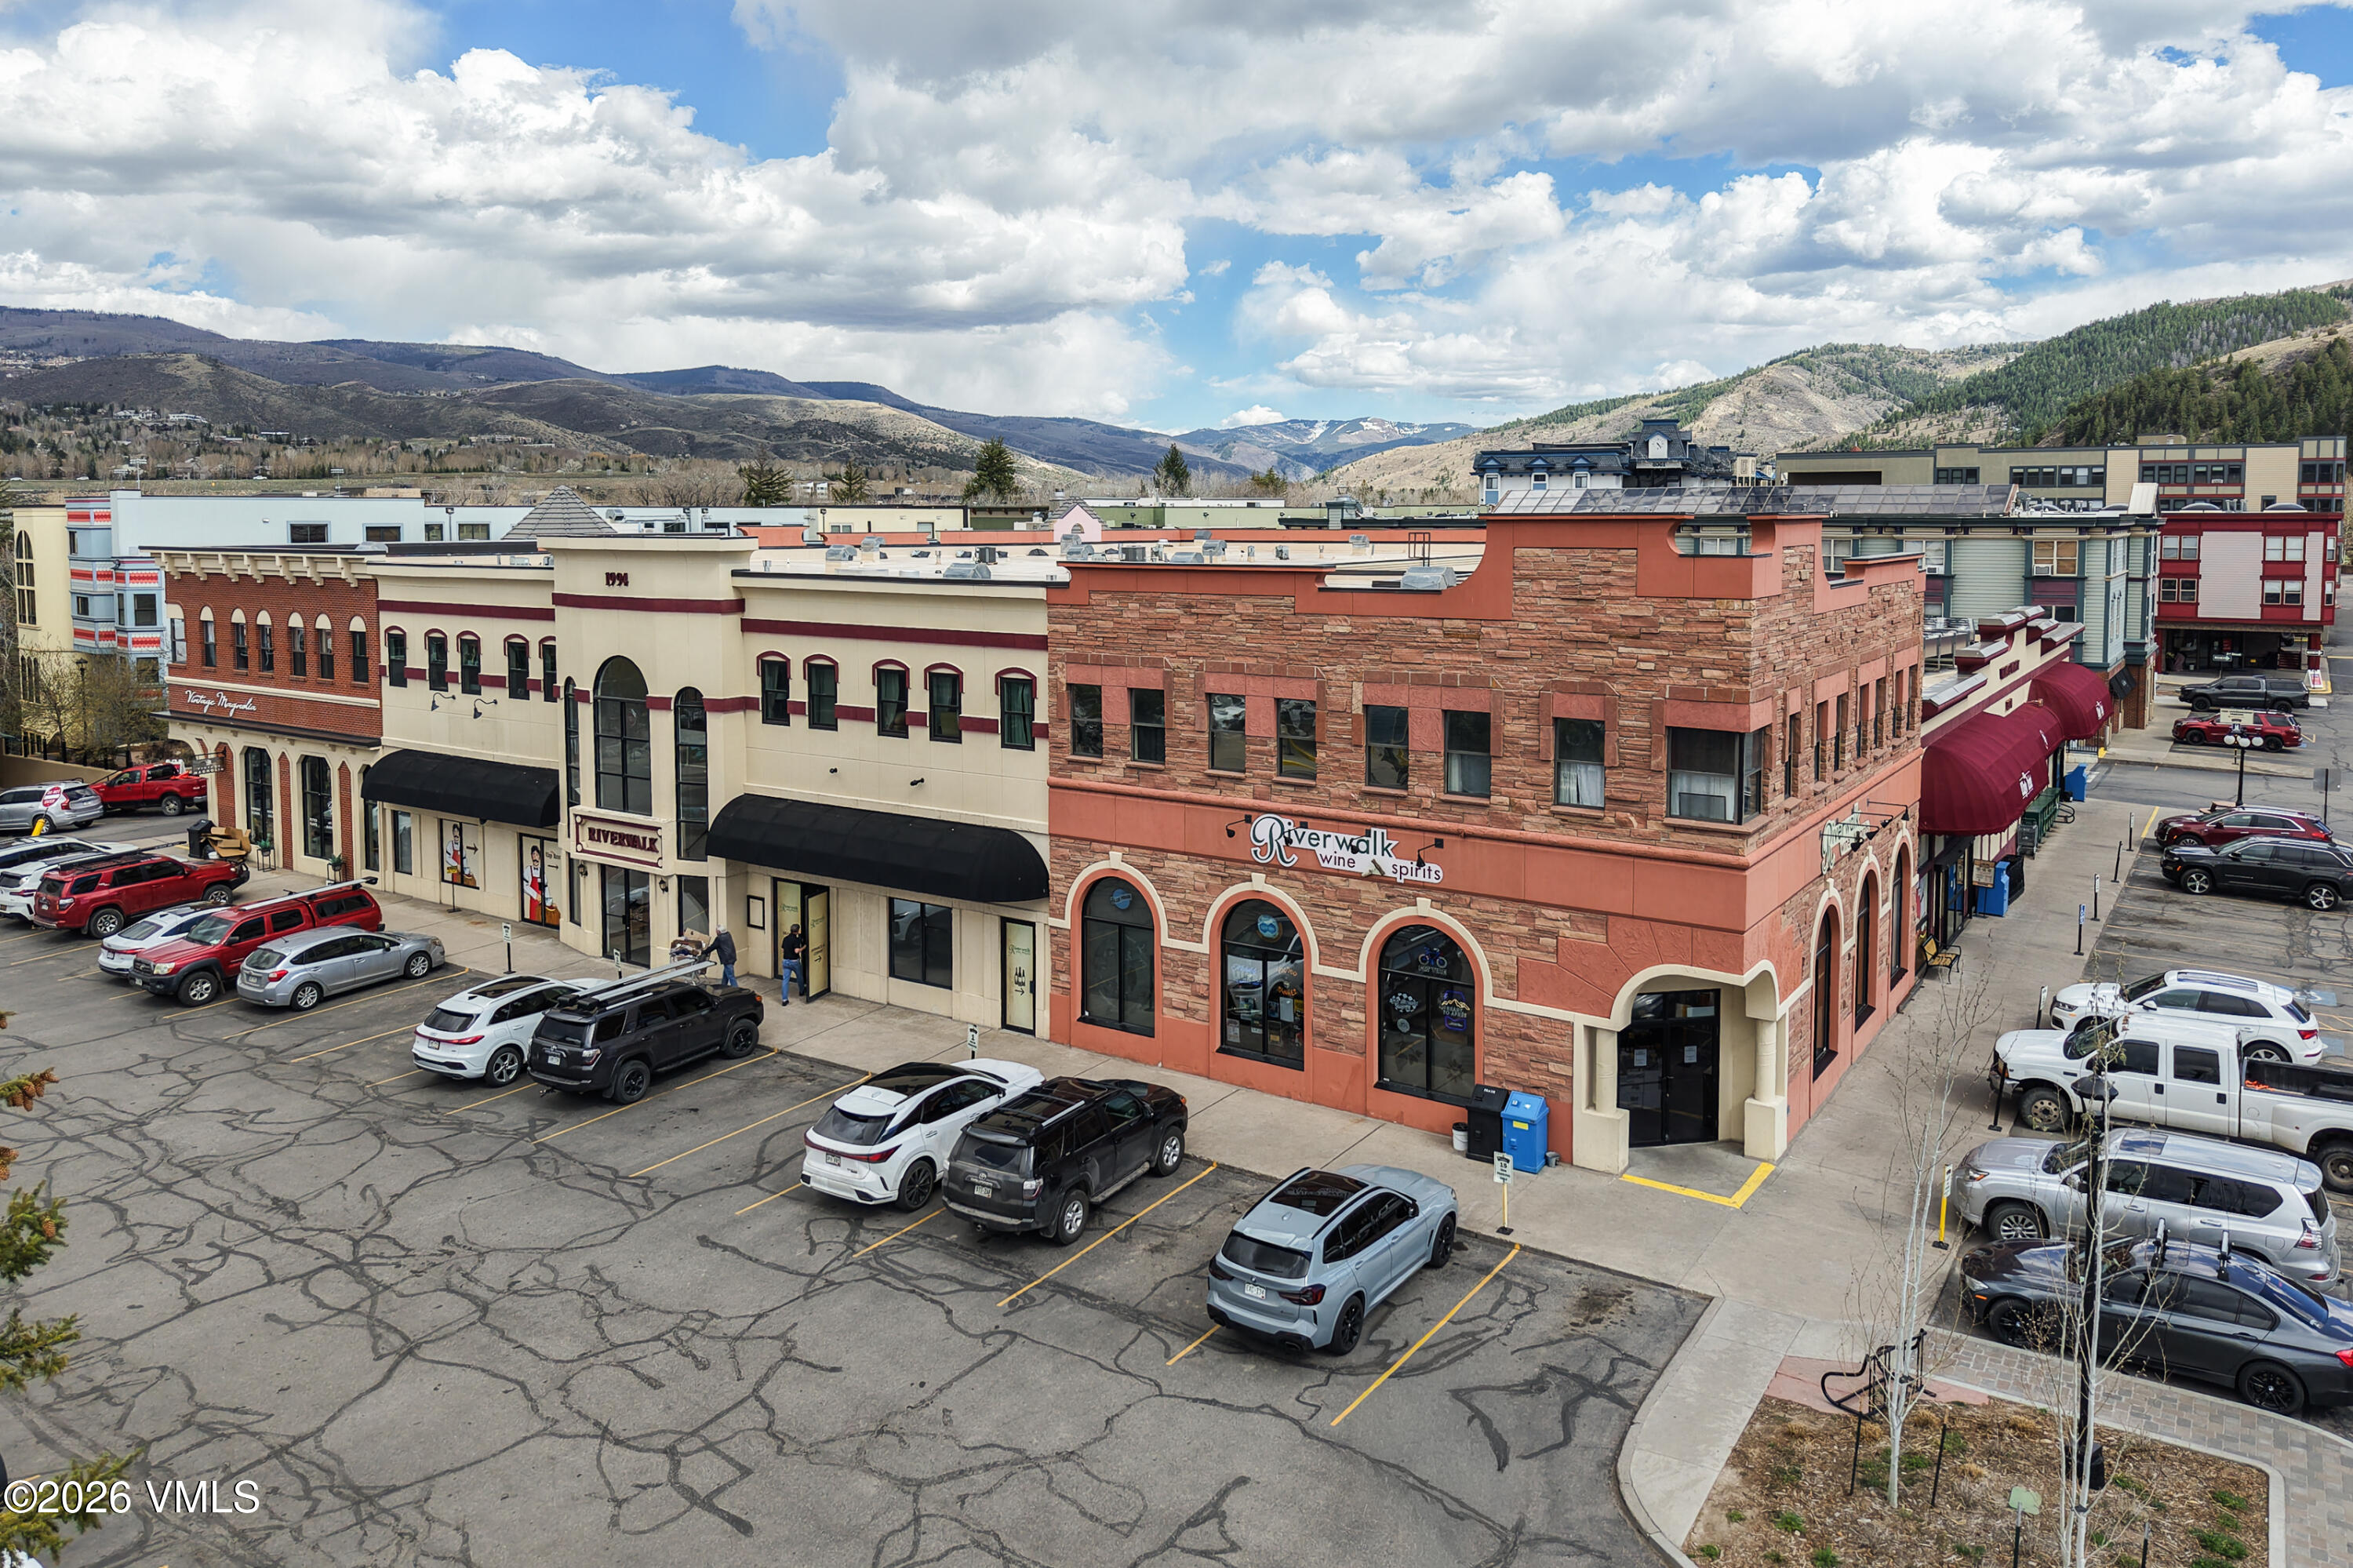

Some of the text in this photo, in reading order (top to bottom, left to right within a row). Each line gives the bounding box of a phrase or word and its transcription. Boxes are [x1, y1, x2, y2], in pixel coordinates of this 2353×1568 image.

[605, 572, 629, 587] 1994
[185, 689, 257, 717] Vintage Magnolia
[587, 827, 659, 853] RIVERWALK
[1252, 816, 1394, 864] Riverwalk
[1319, 851, 1442, 881] wine spirits
